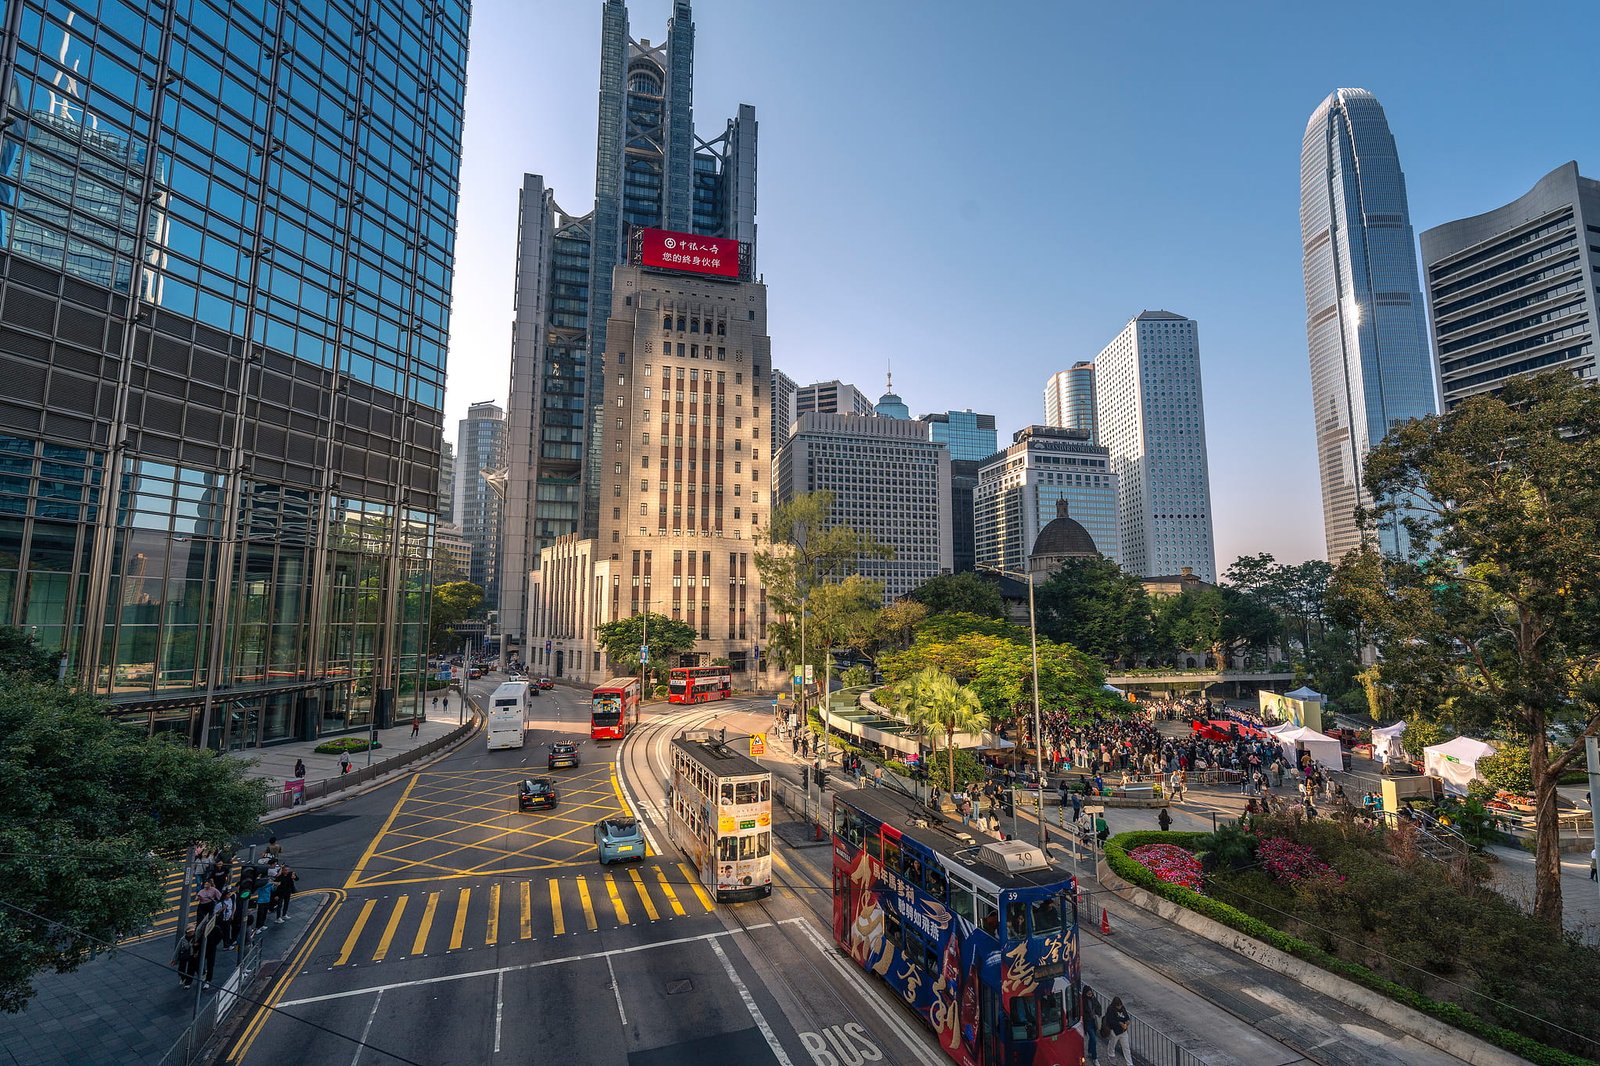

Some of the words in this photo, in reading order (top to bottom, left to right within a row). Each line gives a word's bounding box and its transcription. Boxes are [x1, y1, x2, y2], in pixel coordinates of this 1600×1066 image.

[662, 251, 721, 268] 您的終身伙伴
[1046, 443, 1077, 452] MANDARIN
[1077, 445, 1104, 454] ORIENTAL
[1015, 852, 1033, 867] 39
[1008, 892, 1018, 901] 39
[897, 897, 940, 942] 馳騁如飛燕
[798, 1022, 883, 1066] BUS
